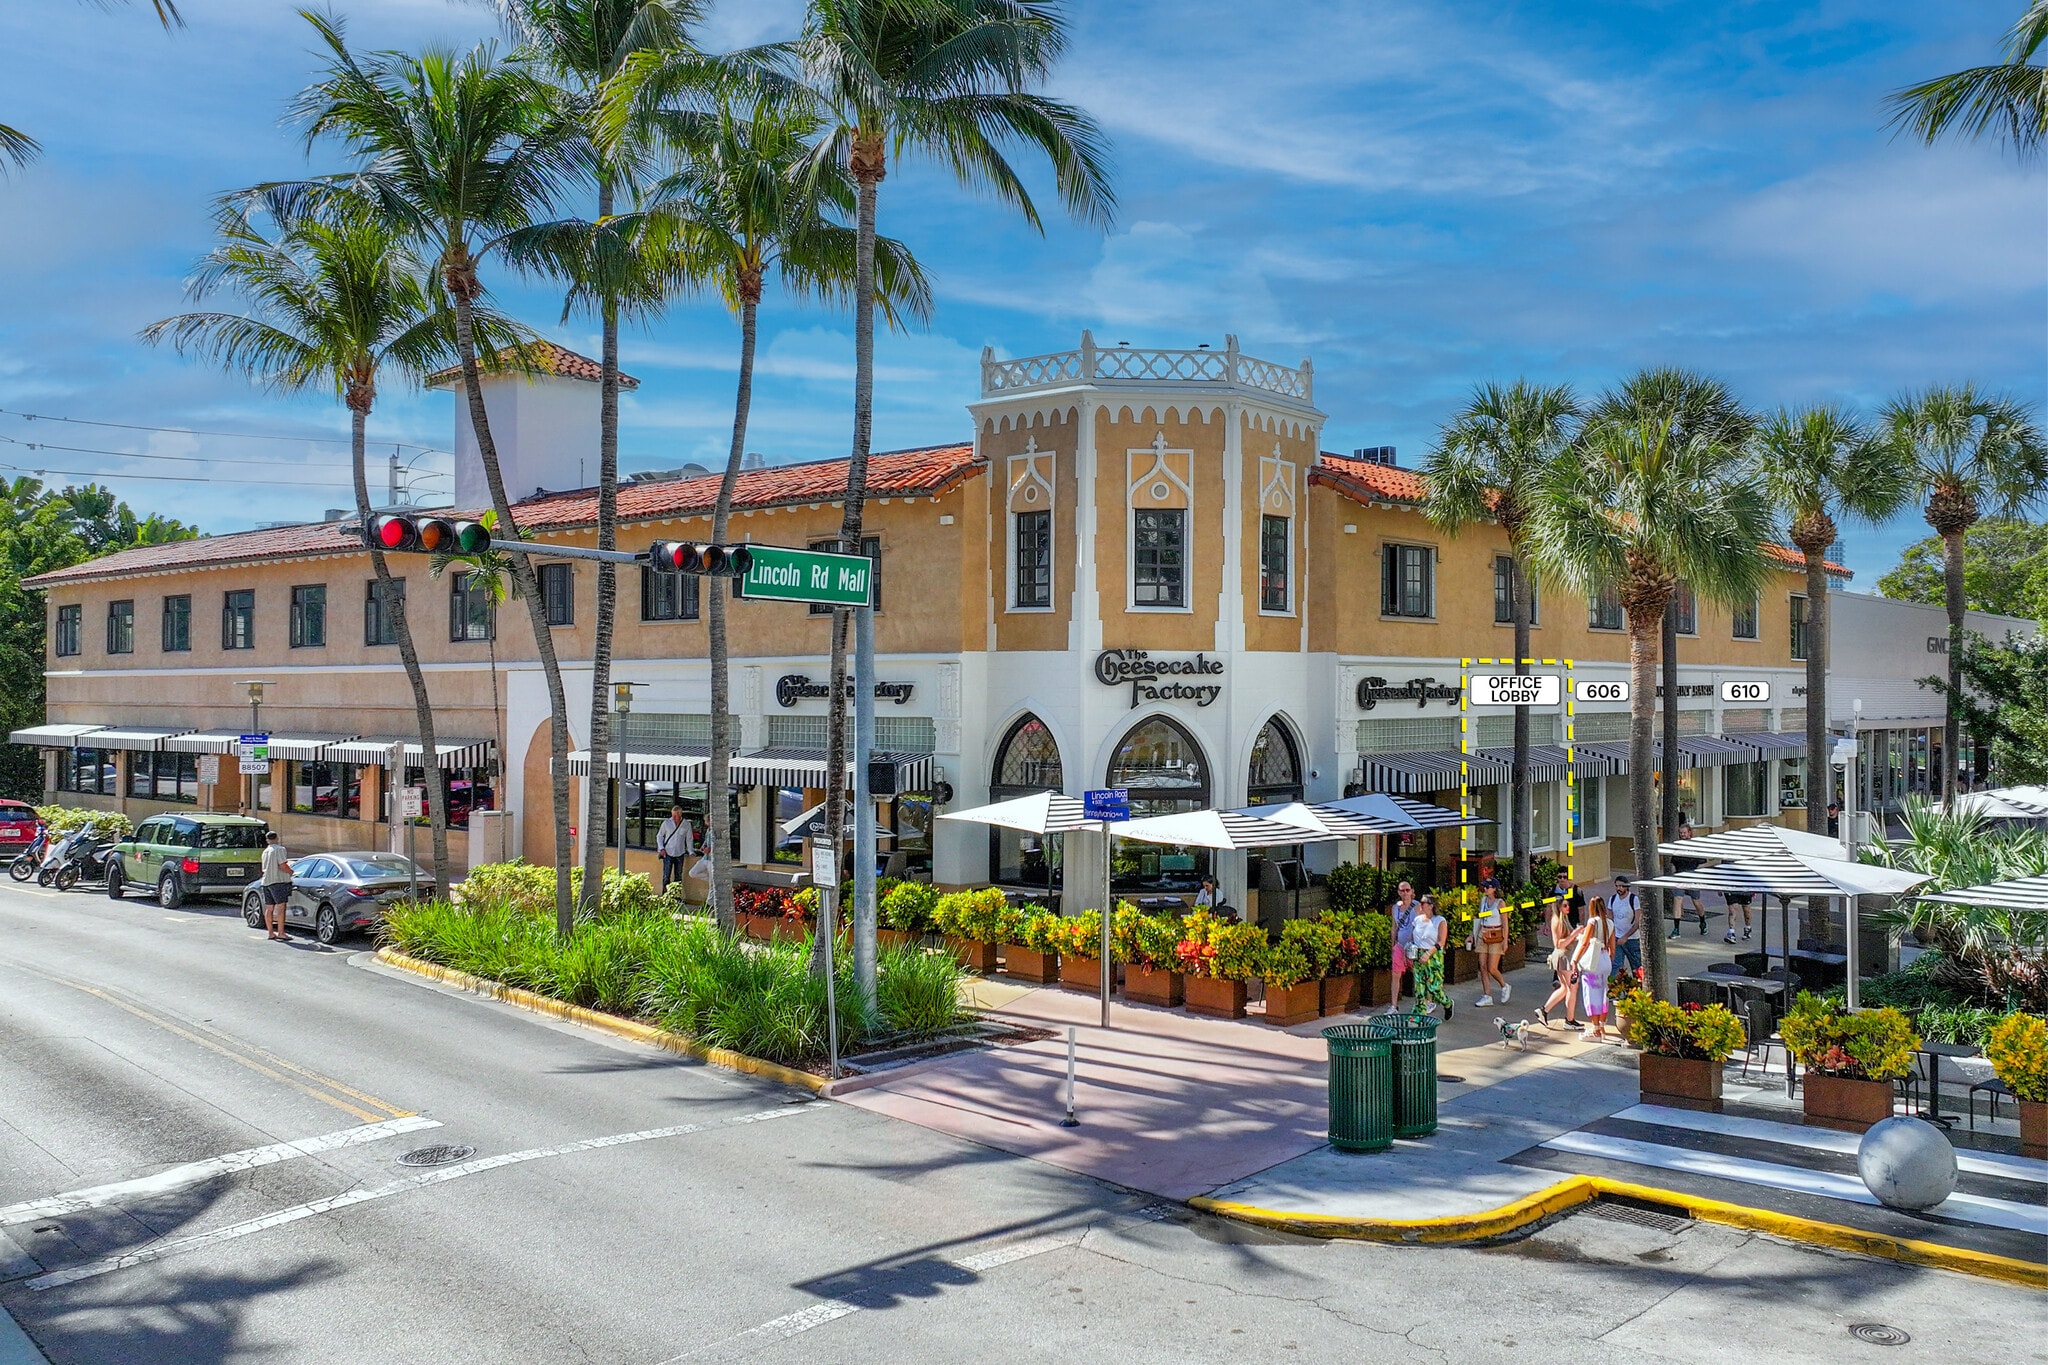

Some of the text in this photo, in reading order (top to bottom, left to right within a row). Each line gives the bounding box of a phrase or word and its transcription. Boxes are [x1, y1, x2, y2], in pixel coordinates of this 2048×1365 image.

[750, 559, 866, 592] Lincoln Rd Mall
[1126, 649, 1148, 660] The
[1927, 637, 1950, 654] GNC
[1095, 649, 1224, 686] Cheesecake
[1120, 675, 1222, 709] Factory
[1358, 677, 1422, 710] Cheesecake
[1091, 790, 1128, 800] Lincoln Road
